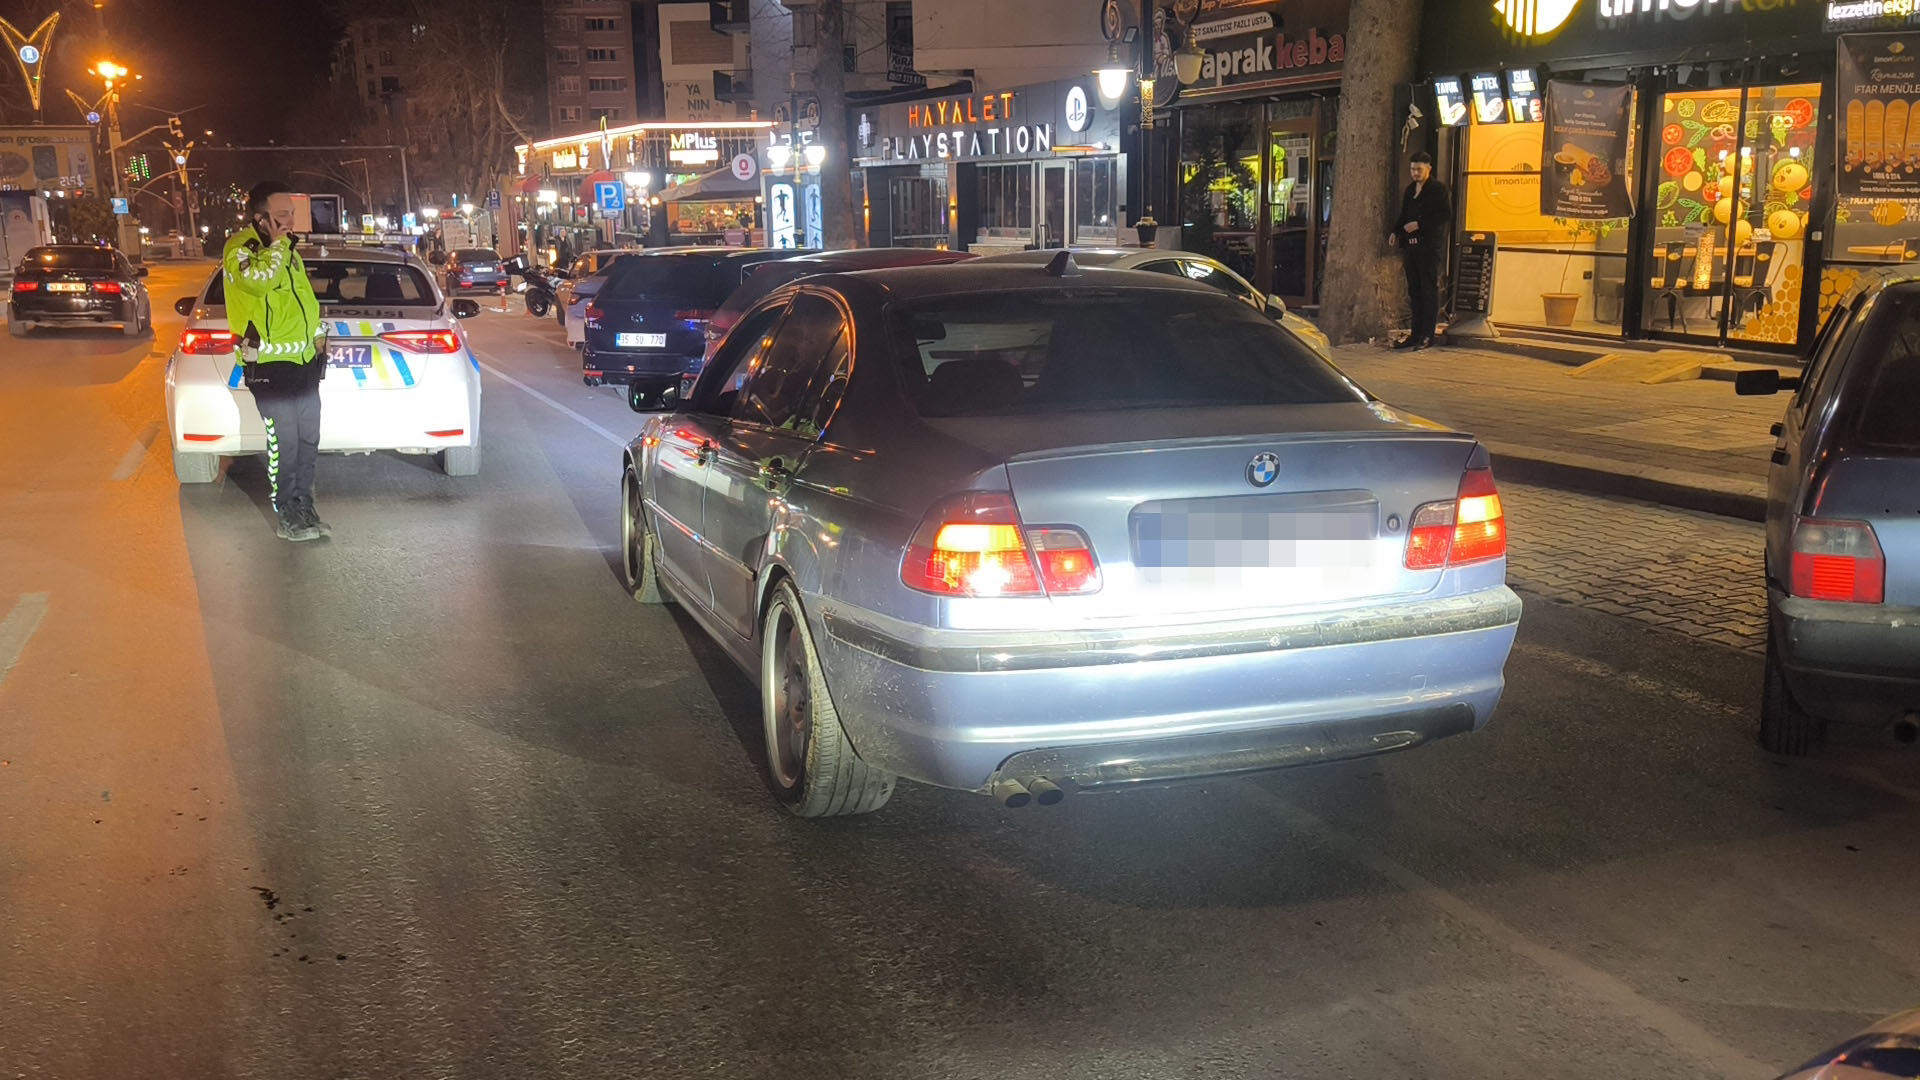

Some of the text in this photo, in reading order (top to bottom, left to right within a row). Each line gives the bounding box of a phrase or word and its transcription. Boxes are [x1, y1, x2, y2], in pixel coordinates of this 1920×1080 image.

[1202, 27, 1345, 87] aprak keba
[908, 92, 1014, 128] HAYALET
[670, 132, 717, 149] MPlus
[882, 123, 1050, 161] PLAYSTATION
[600, 184, 617, 208] P
